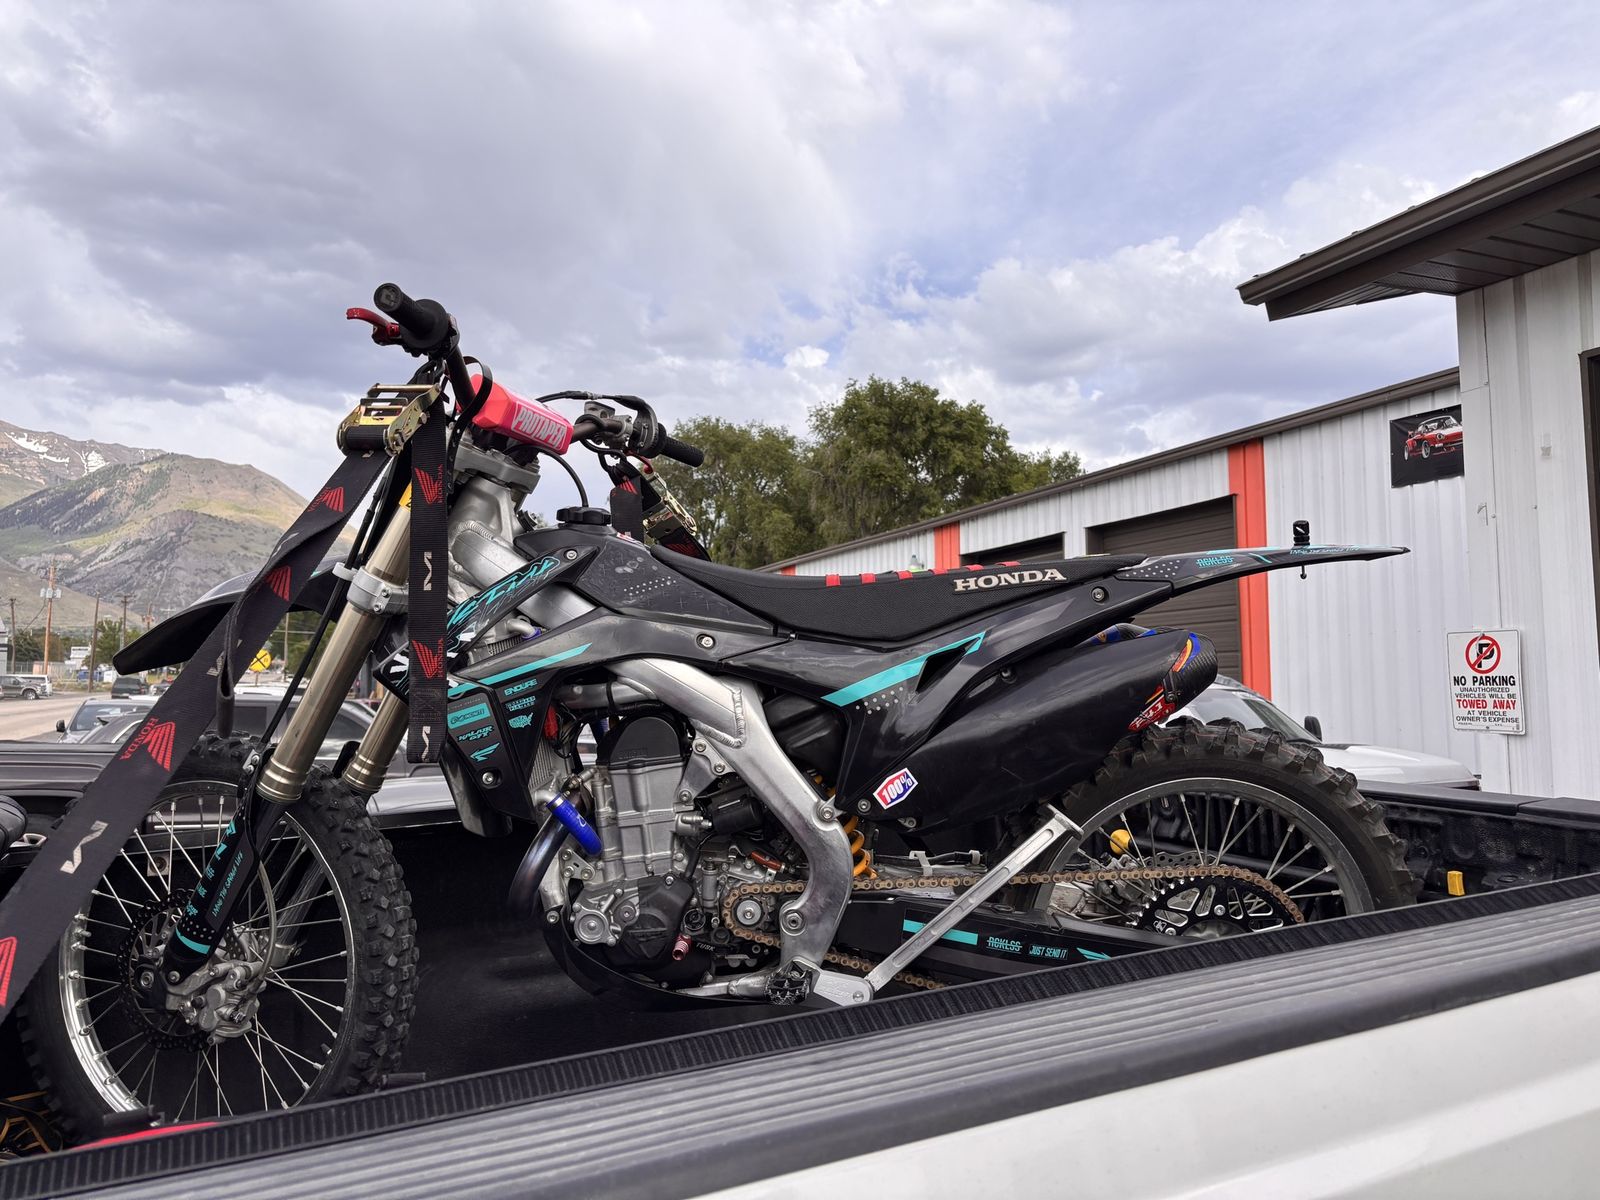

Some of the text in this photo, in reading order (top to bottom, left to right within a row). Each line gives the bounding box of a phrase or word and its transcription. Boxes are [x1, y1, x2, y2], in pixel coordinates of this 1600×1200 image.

[512, 407, 567, 448] PROTAPER
[954, 568, 1067, 592] HONDA
[504, 679, 538, 696] ENDURE
[1453, 675, 1516, 686] NO PARKING
[1456, 699, 1517, 710] TOWED AWAY
[120, 717, 160, 760] HONDA
[882, 772, 913, 803] 100%
[1029, 945, 1067, 959] JUST SEND IT
